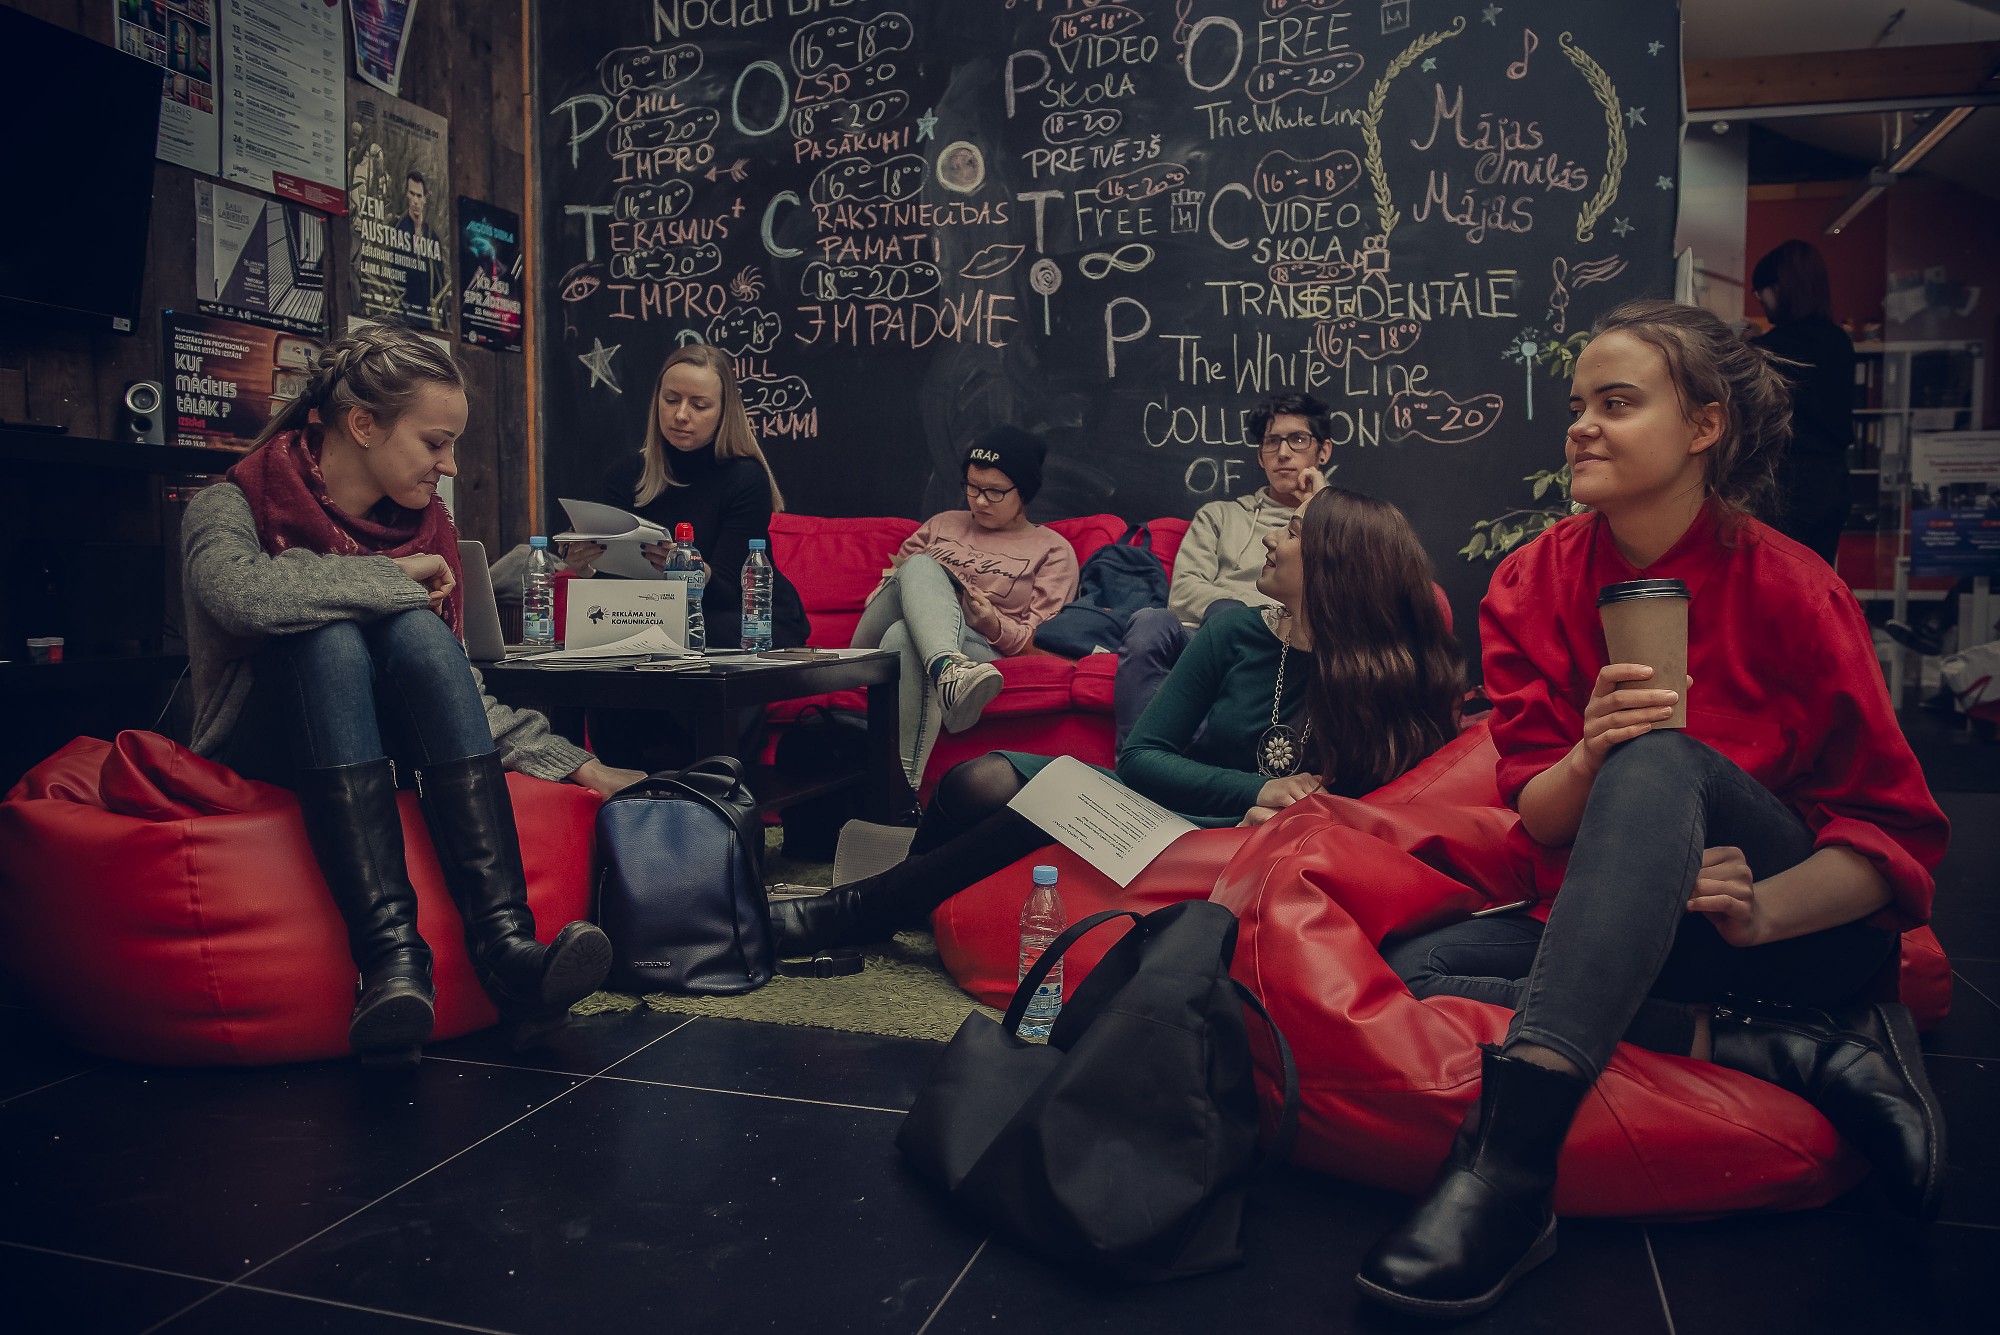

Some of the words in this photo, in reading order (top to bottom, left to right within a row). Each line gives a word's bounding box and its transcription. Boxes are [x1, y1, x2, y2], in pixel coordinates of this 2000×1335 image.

[1056, 35, 1159, 74] VIDEO
[1258, 12, 1352, 64] FREE
[795, 72, 851, 103] LSD
[615, 93, 685, 123] CHILL
[1194, 100, 1252, 140] The
[613, 143, 716, 182] IMPRO
[794, 127, 909, 164] PASĀKUMI
[360, 194, 385, 220] ZEM
[1261, 202, 1361, 234] VIDEO
[361, 218, 412, 253] AUSTRAS
[413, 234, 442, 261] KOKA
[816, 233, 942, 264] PAMATI
[1252, 236, 1346, 264] SKOLA
[607, 281, 727, 322] IMPRO
[1158, 334, 1227, 386] The
[1233, 332, 1331, 394] White
[1344, 337, 1432, 398] Line
[970, 448, 1001, 463] KRAP
[1184, 456, 1246, 494] OF
[611, 616, 664, 626] KOMUNIKĀCIJA
[612, 609, 644, 618] REKLĀMA
